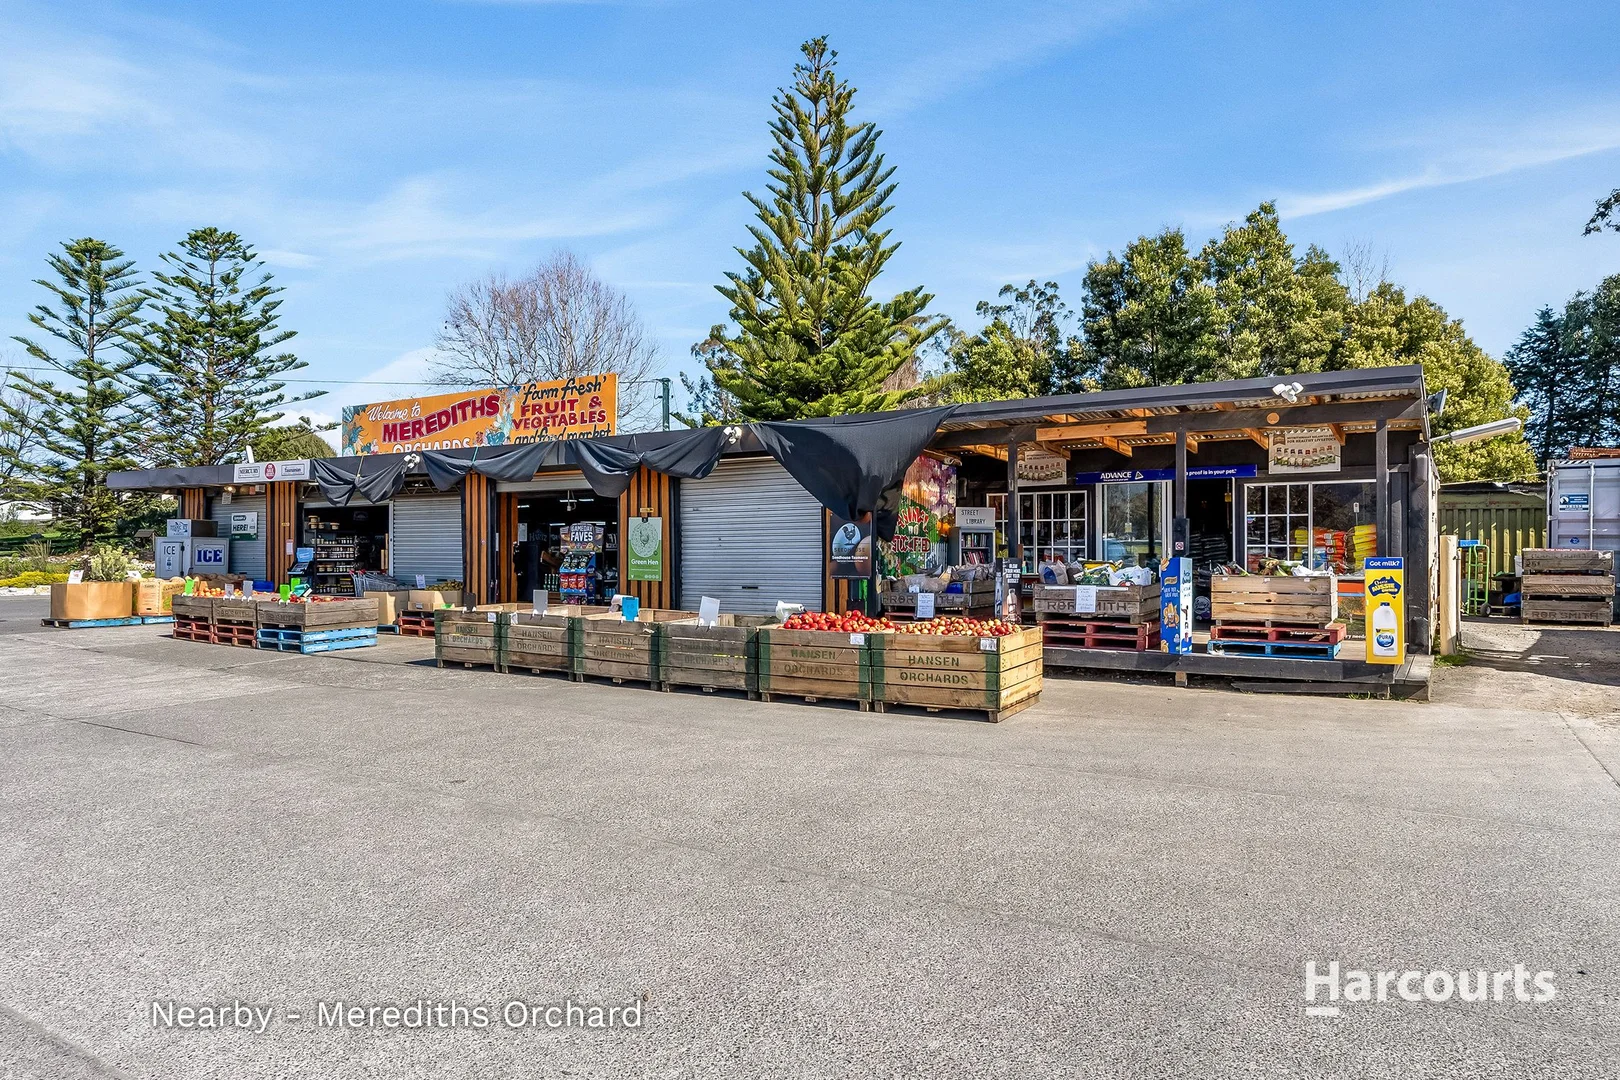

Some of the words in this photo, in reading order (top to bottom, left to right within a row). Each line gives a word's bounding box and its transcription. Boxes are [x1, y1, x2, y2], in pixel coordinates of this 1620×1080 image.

[366, 405, 409, 422] Welcome
[411, 402, 422, 417] to
[520, 399, 579, 417] FRUIT
[589, 396, 602, 409] &
[382, 395, 500, 443] MEREDITHS
[512, 410, 607, 430] VEGETABLES
[393, 438, 470, 453] ORCHARDS
[1100, 471, 1132, 479] ADVANCE
[571, 532, 594, 542] FAVES
[163, 545, 176, 555] ICE
[197, 549, 223, 563] ICE
[455, 625, 478, 634] HANSEN
[522, 629, 553, 639] HANSEN
[516, 642, 557, 651] ORCHARDS
[599, 636, 634, 646] HANSEN
[791, 649, 836, 660] HANSEN
[908, 655, 960, 667] HANSEN
[784, 664, 844, 677] ORCHARDS
[900, 671, 969, 685] ORCHARDS
